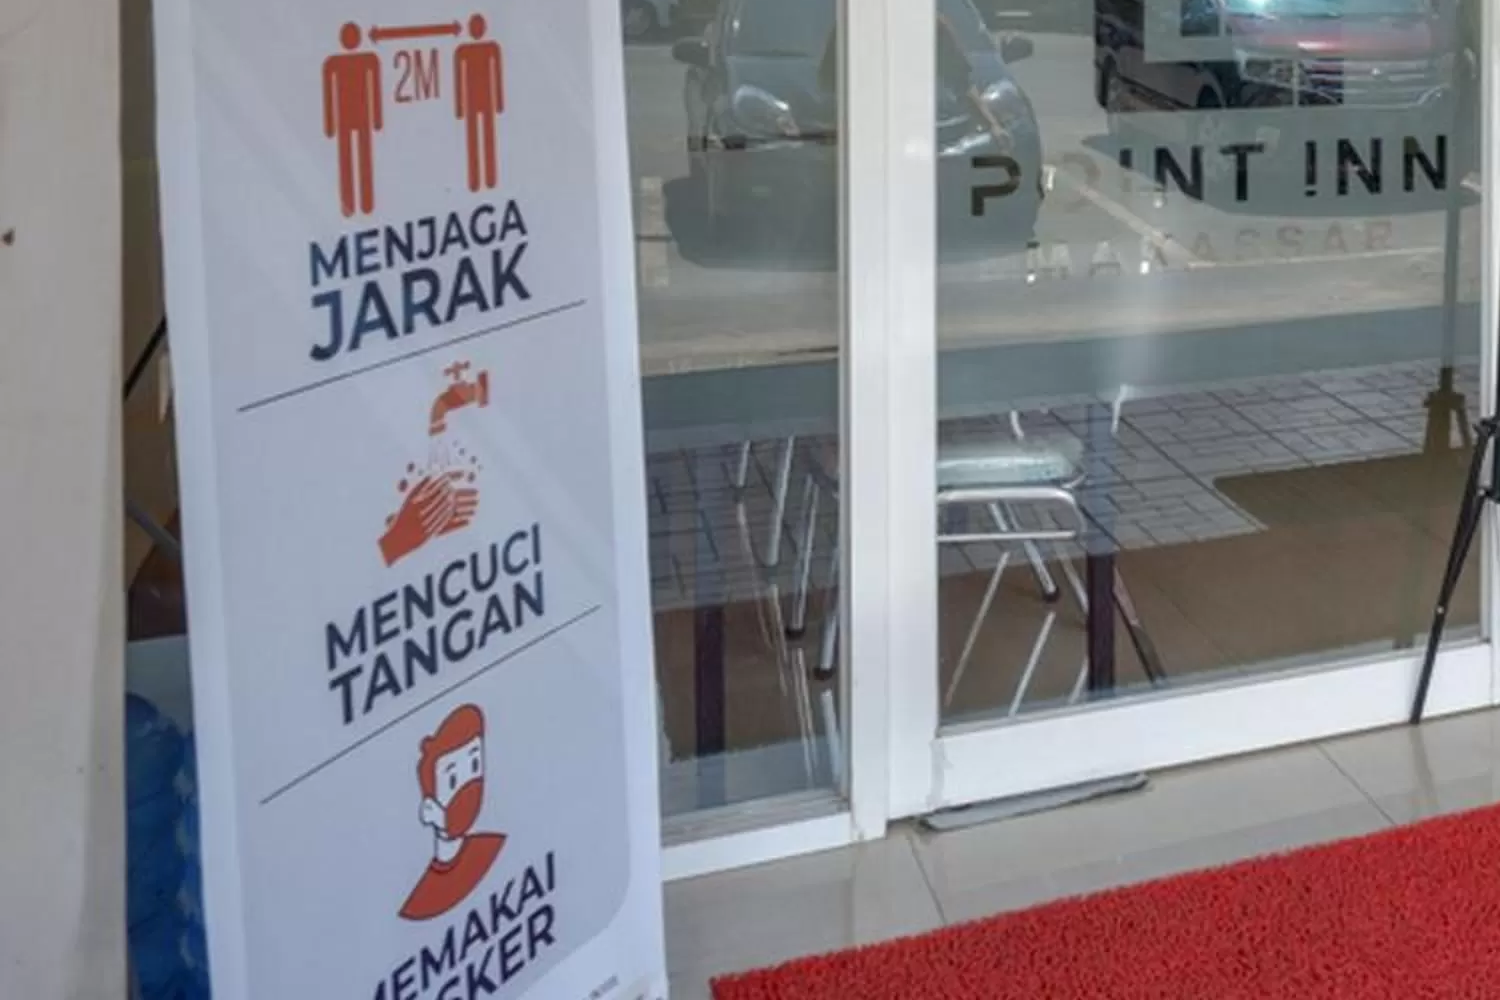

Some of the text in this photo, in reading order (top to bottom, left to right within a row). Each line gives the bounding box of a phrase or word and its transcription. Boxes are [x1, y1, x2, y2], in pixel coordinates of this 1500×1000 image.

[392, 48, 441, 104] 2M
[308, 199, 528, 288] MENJAGA
[308, 242, 531, 362] JARAK
[325, 523, 543, 672] MENCUCI
[329, 571, 545, 725] TANGAN
[374, 851, 556, 1000] EMAKAI
